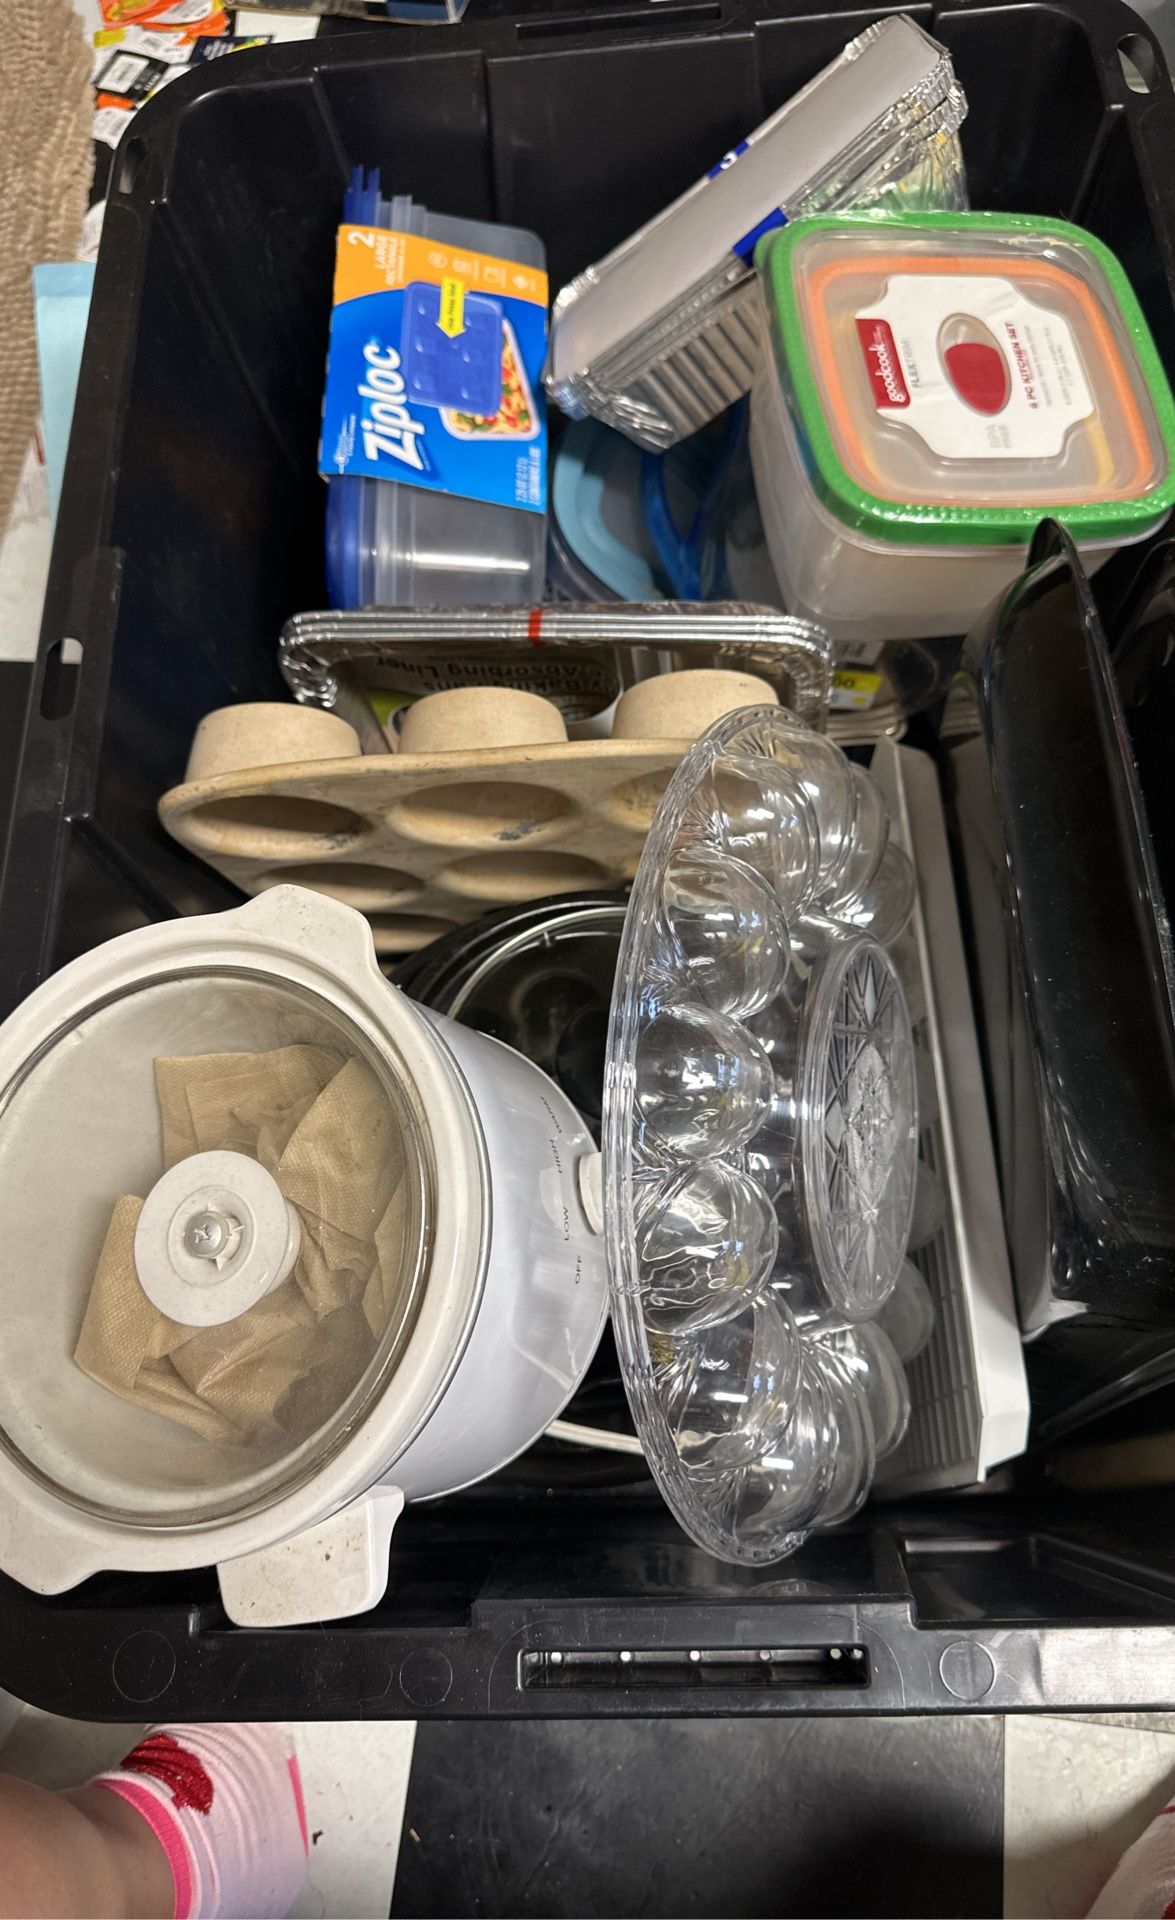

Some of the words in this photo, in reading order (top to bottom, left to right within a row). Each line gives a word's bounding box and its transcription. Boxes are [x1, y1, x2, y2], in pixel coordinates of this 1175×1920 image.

[347, 231, 375, 249] 2
[1005, 321, 1017, 340] SET
[868, 343, 906, 403] goodcook
[1011, 342, 1031, 384] KITCHEN
[358, 343, 425, 471] Ziploc
[1024, 386, 1036, 400] PC
[376, 657, 438, 679] Liner
[448, 661, 579, 679] Absorbing
[540, 1095, 563, 1133] WARM
[550, 1138, 563, 1174] HIGH
[563, 1206, 571, 1241] LOW
[574, 1254, 582, 1285] OFF
